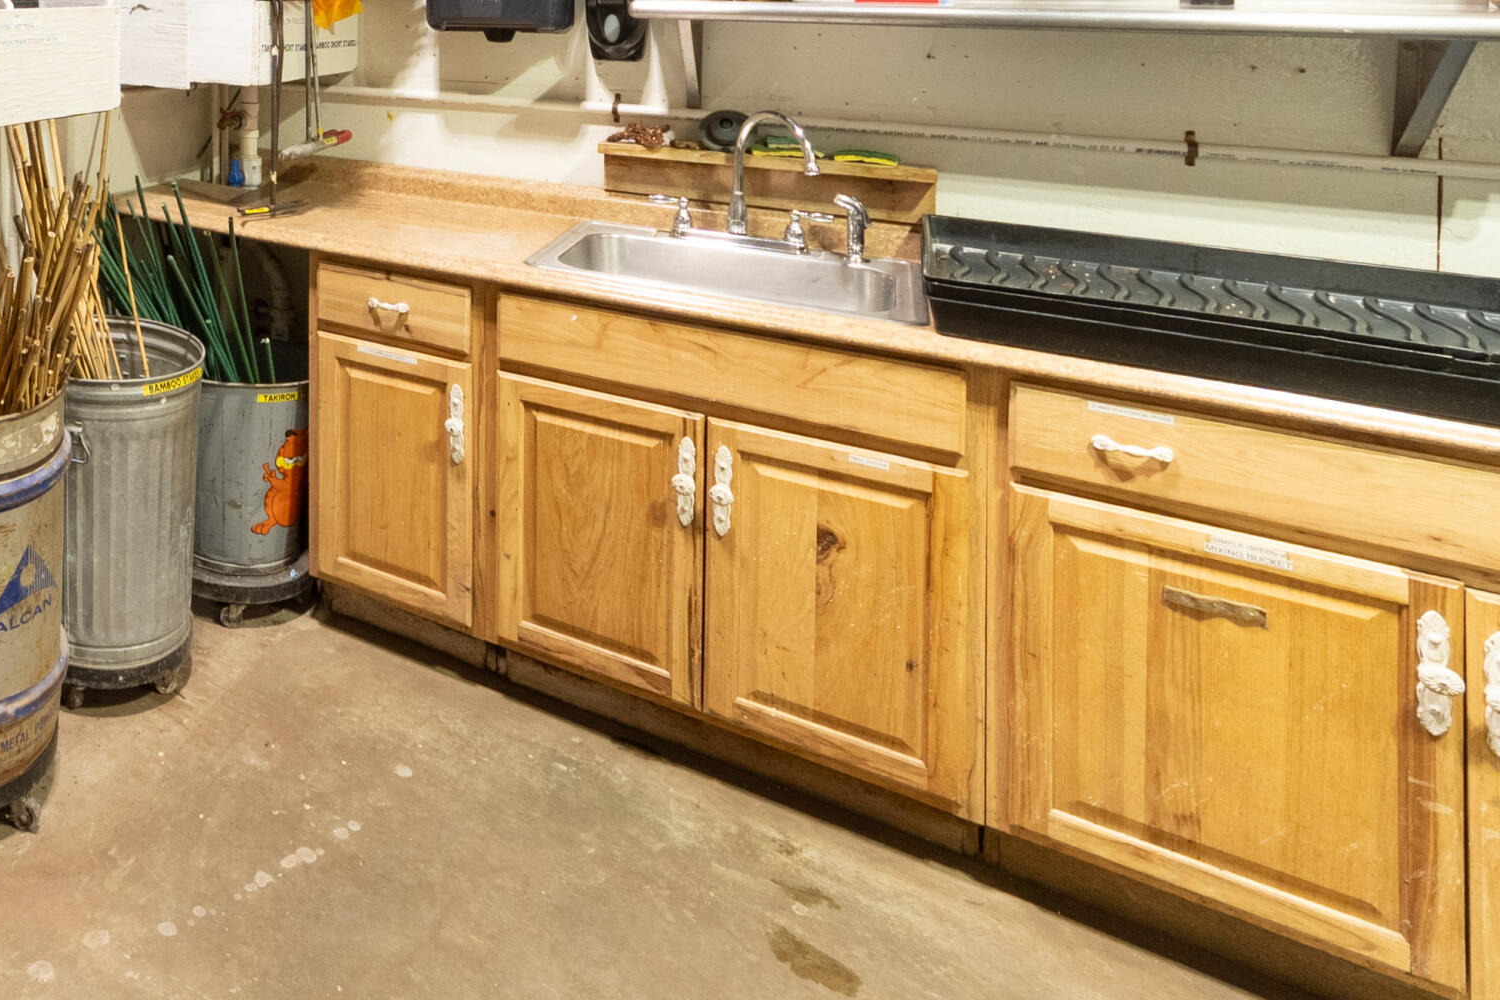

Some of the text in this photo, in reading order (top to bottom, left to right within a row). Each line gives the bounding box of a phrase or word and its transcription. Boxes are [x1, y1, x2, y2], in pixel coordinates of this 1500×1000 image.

[149, 378, 181, 394] BAMBOO
[264, 393, 296, 402] TAKIRON
[1205, 544, 1291, 569] MIXING BUCKET
[0, 731, 30, 752] METAL
